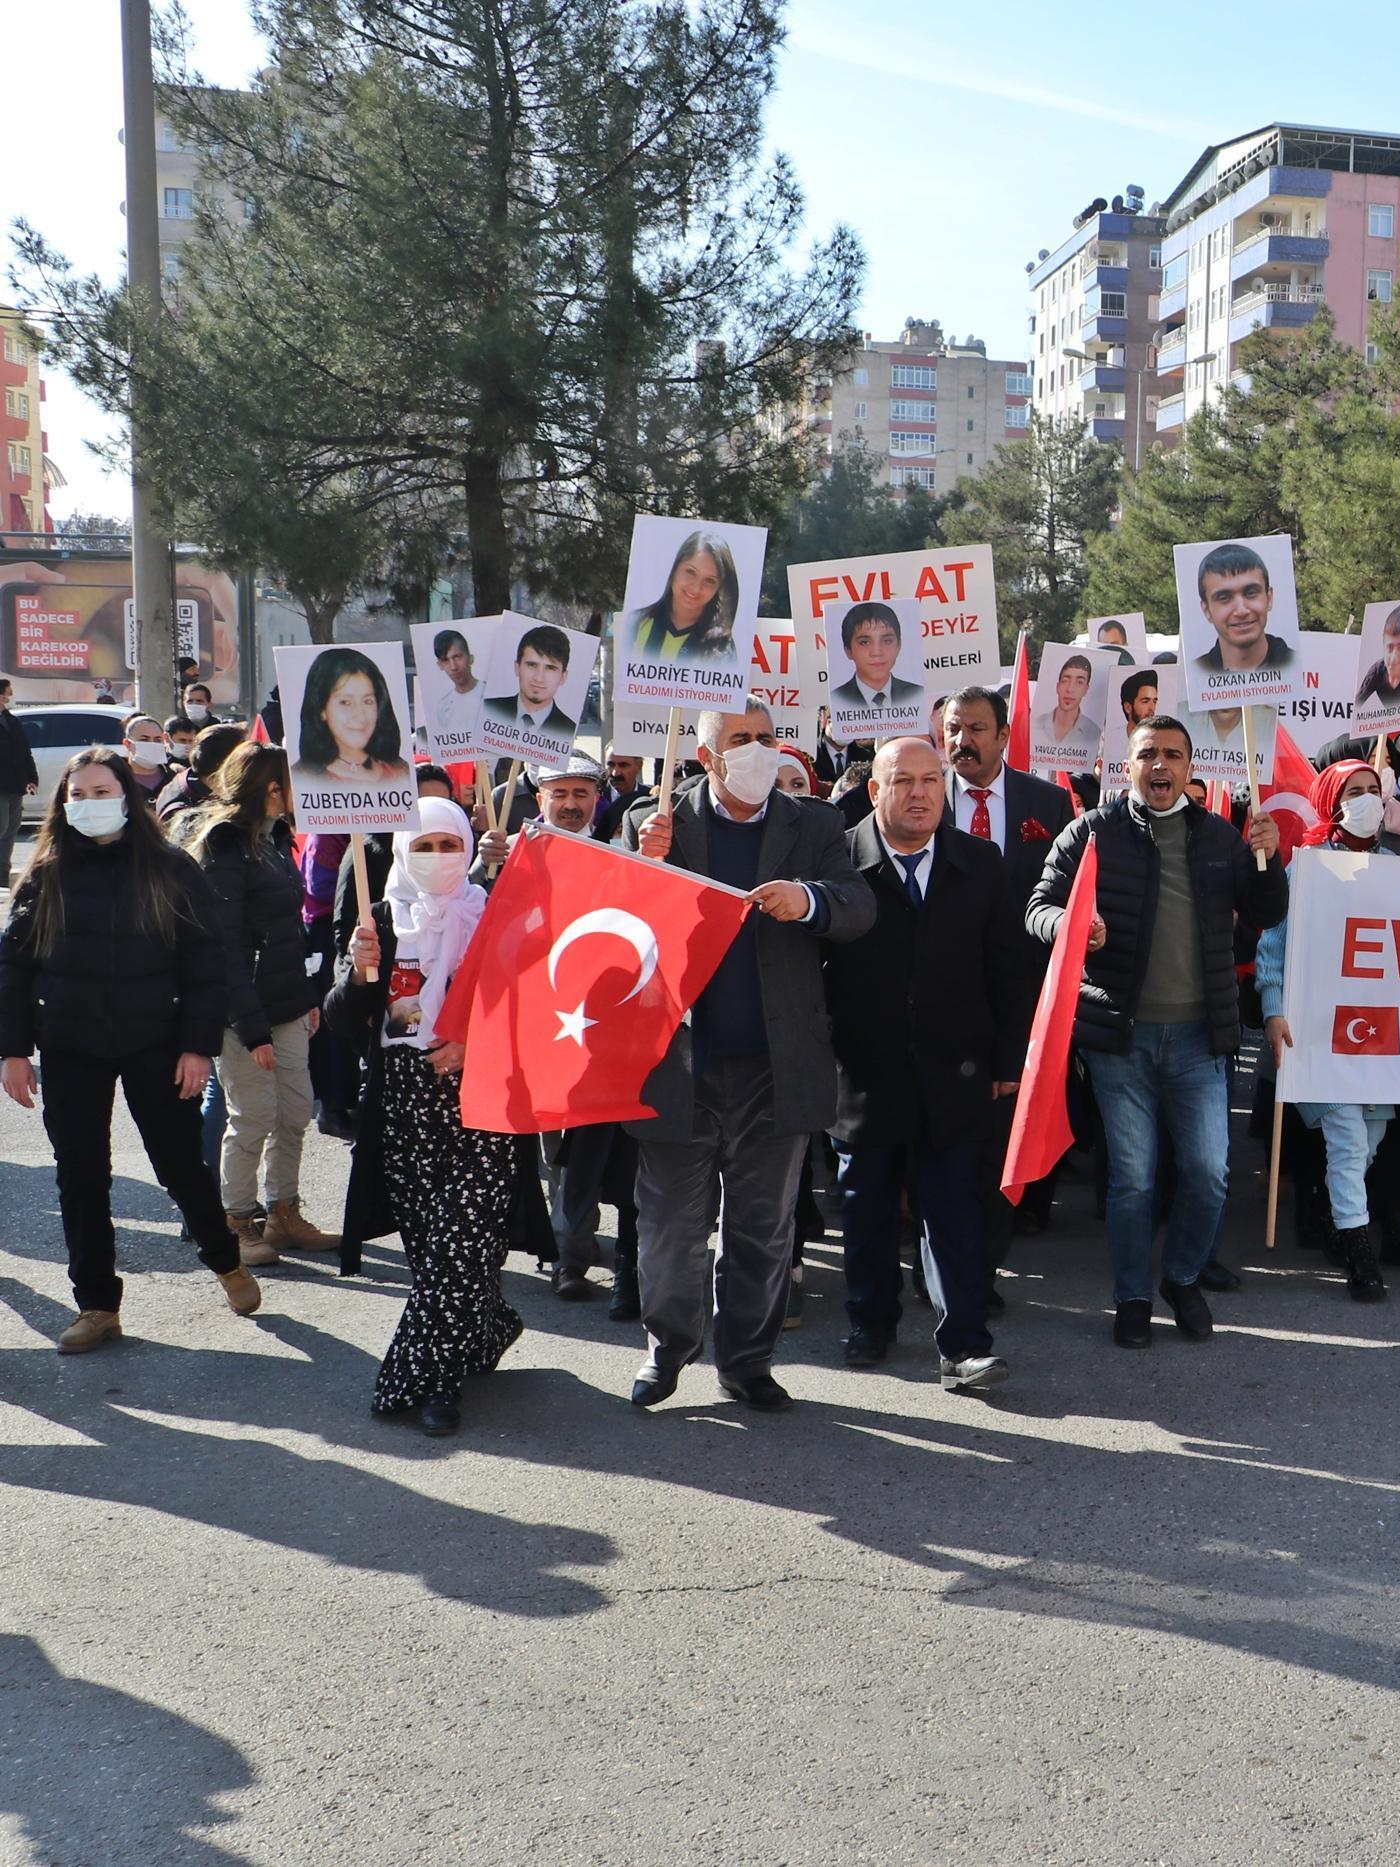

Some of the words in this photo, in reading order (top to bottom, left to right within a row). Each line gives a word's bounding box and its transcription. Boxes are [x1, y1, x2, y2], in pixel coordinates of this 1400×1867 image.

[19, 599, 39, 609] BU
[19, 613, 75, 624] SADECE
[20, 624, 44, 638] BİR
[21, 641, 89, 652] KAREKOD
[21, 653, 85, 666] DEĞİLDİR
[923, 649, 983, 670] NNELERİ
[626, 662, 689, 683] KADRİYE
[693, 670, 744, 689] TURAN
[1208, 673, 1246, 688] ÖZKAN
[1248, 670, 1282, 684] AYDIN
[627, 683, 674, 697] EVLADIMI
[674, 685, 732, 704] İSTİYORUM!
[1201, 689, 1241, 702] EVLADIMI
[1242, 684, 1292, 698] İSTİYORUM!
[836, 708, 884, 722] MEHMET
[886, 706, 920, 718] TOKAY
[1356, 707, 1398, 721] MUHAMMED
[841, 724, 876, 734] EVLADIMI
[876, 721, 919, 732] İSTİYORUM!
[434, 731, 472, 746] YUSUF
[483, 718, 520, 741] ÖZGÜR
[521, 731, 570, 755] ÖDÜMLÜ
[440, 747, 475, 758] EVLADIMI
[482, 735, 518, 754] EVLADIMI
[516, 745, 559, 764] İSTİYORUM!
[1034, 744, 1056, 755] YAVUZ
[1057, 746, 1088, 758] ÇAĞMAR
[1192, 746, 1220, 761] ACİT
[301, 791, 375, 809] ZUBEYDA
[377, 790, 413, 811] KOÇ
[307, 815, 350, 825] EVLADIMI
[351, 812, 407, 825] İSTİYORUM!
